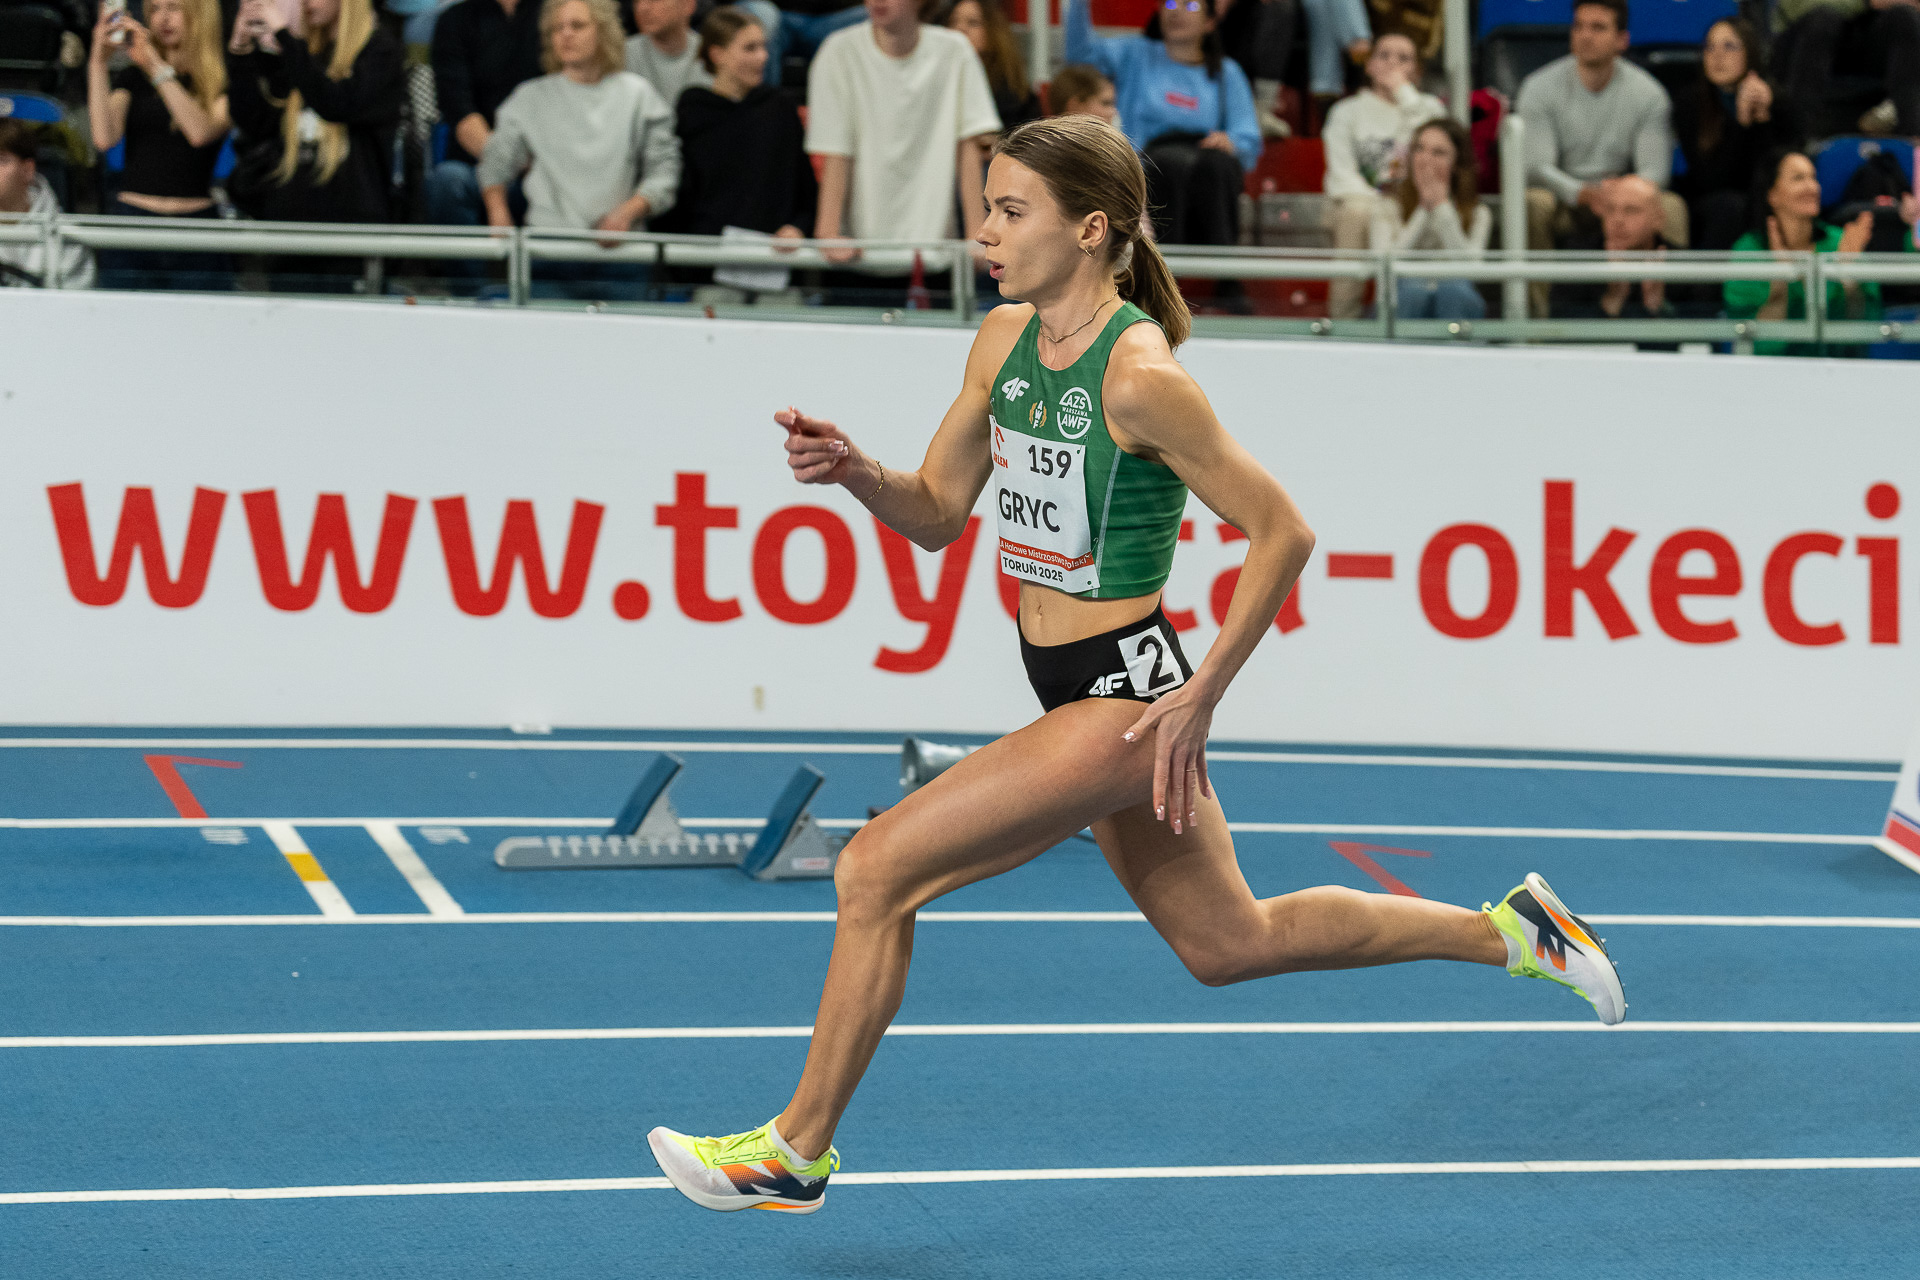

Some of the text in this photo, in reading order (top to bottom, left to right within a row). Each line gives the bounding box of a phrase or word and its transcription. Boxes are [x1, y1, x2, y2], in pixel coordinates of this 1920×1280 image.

[1001, 376, 1030, 402] 4F
[1066, 395, 1086, 409] AZS
[1061, 413, 1084, 430] AWF
[1062, 406, 1088, 418] WARSZAWA
[1027, 444, 1072, 479] 159
[998, 487, 1061, 533] GRYC
[1004, 541, 1028, 555] Halowe
[1002, 556, 1064, 583] TORUŃ 2025
[1136, 634, 1177, 692] 2
